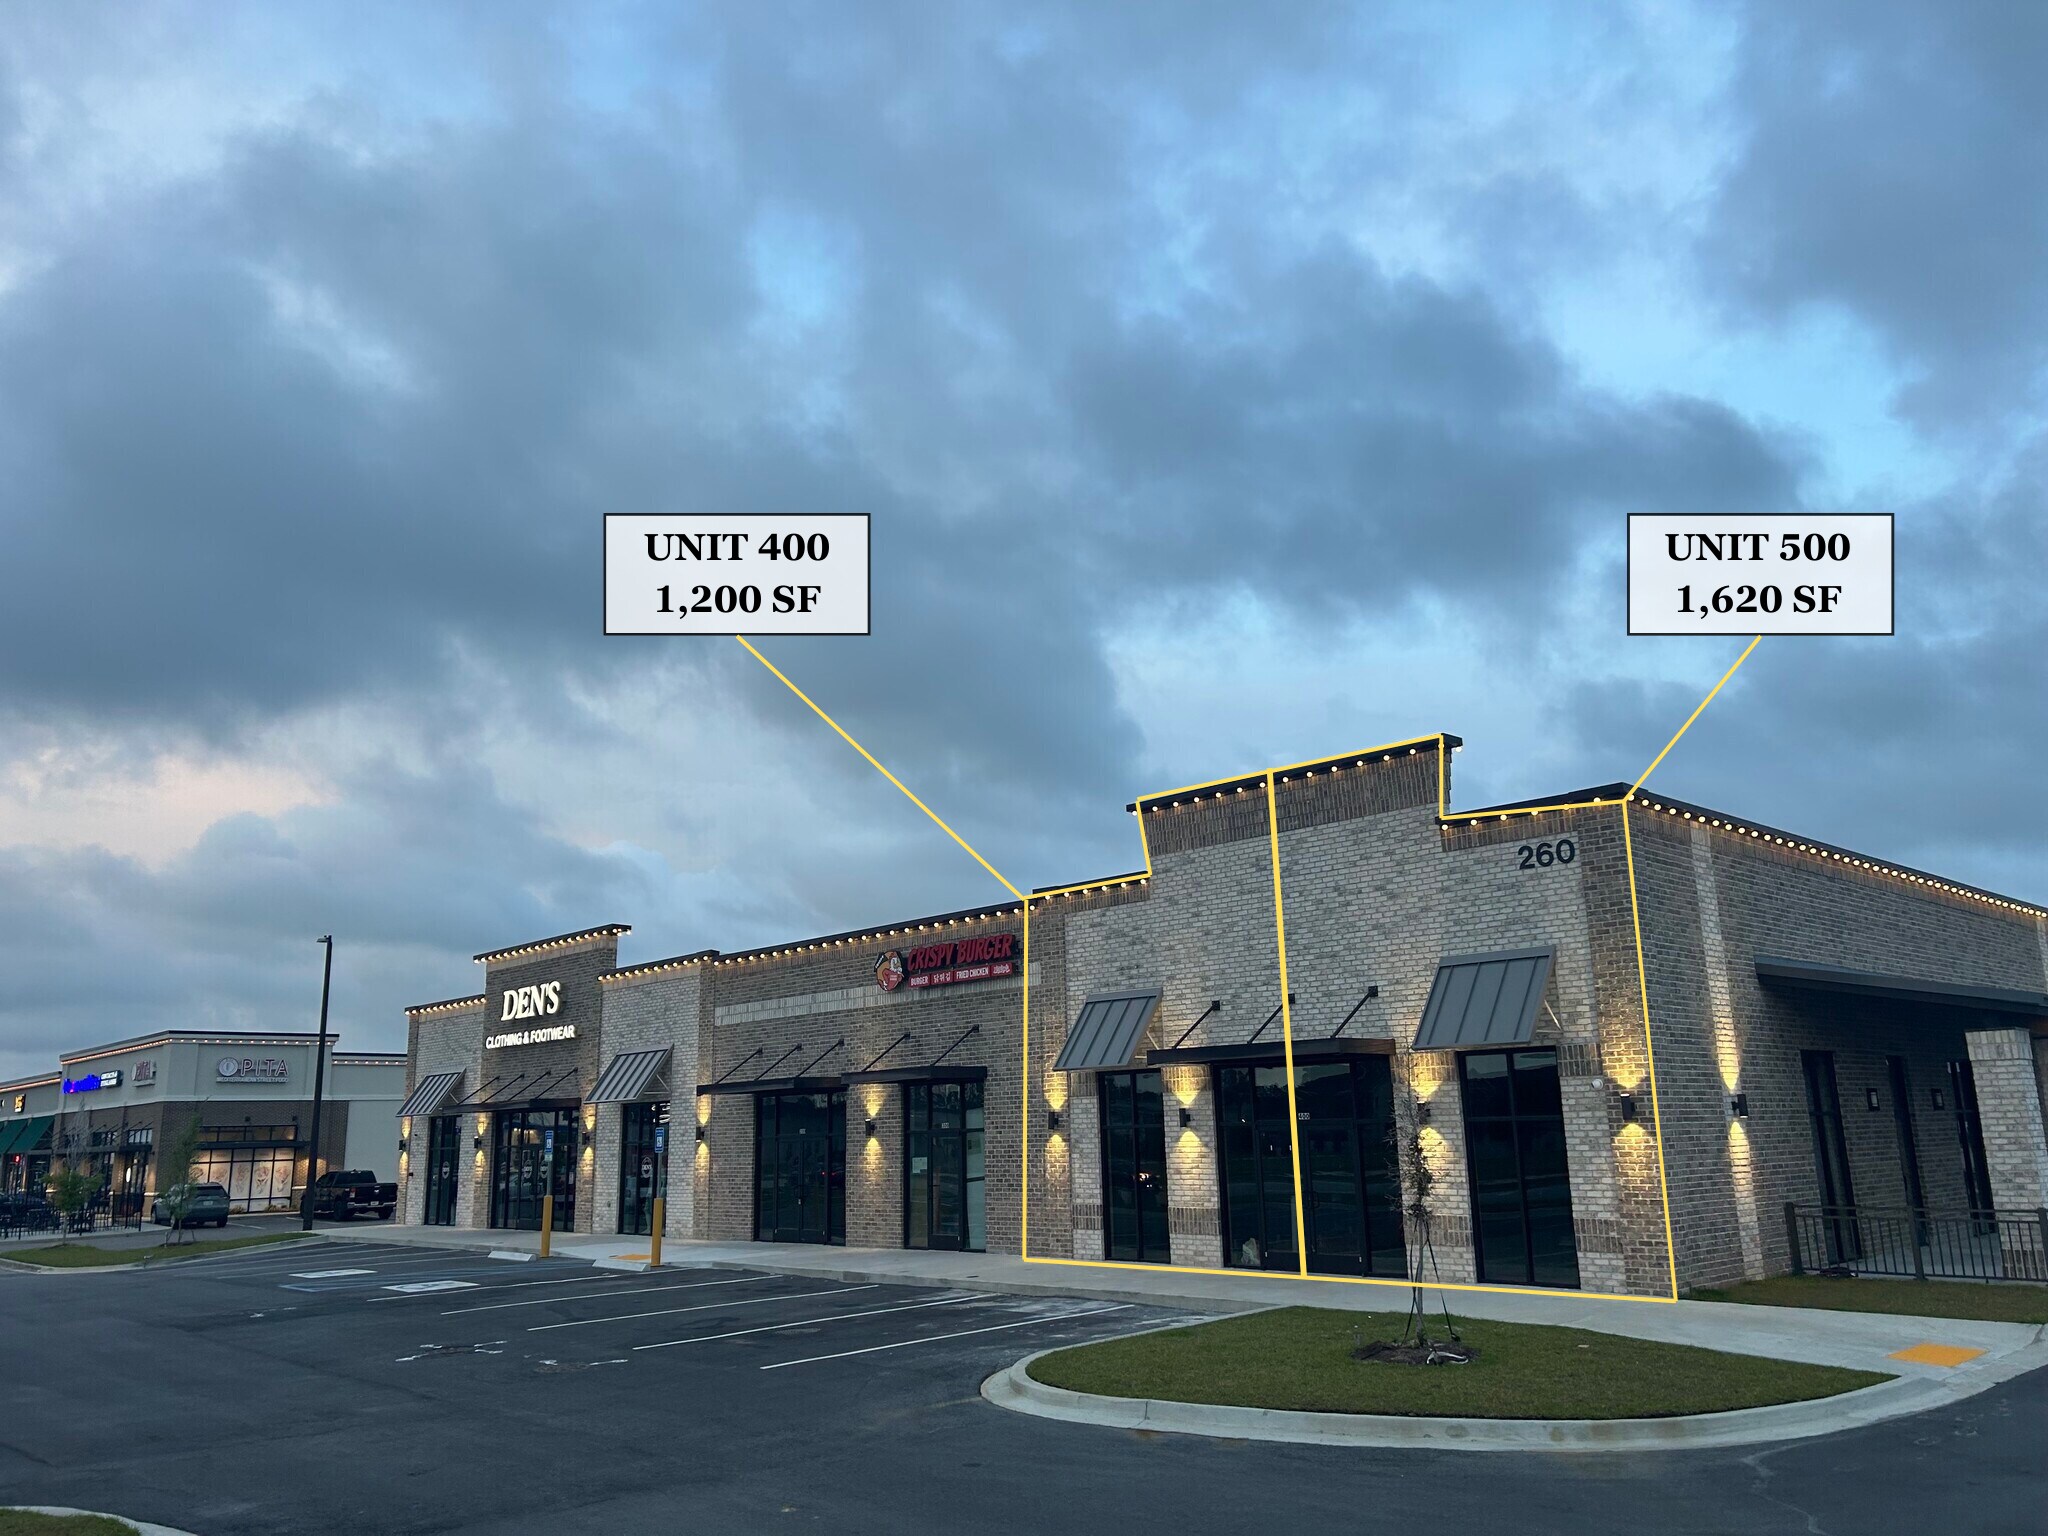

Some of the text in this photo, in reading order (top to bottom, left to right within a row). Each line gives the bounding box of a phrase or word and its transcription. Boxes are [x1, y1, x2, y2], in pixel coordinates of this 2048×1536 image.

[1517, 839, 1576, 870] 260
[907, 943, 954, 971] CRISPY
[957, 933, 1014, 963] BURGER
[910, 975, 929, 986] BURGER
[956, 969, 970, 979] FRIED
[970, 967, 989, 978] CHICKEN
[501, 981, 560, 1021] DEN'S
[486, 1025, 576, 1049] CLOTHING & FOOTWEAR
